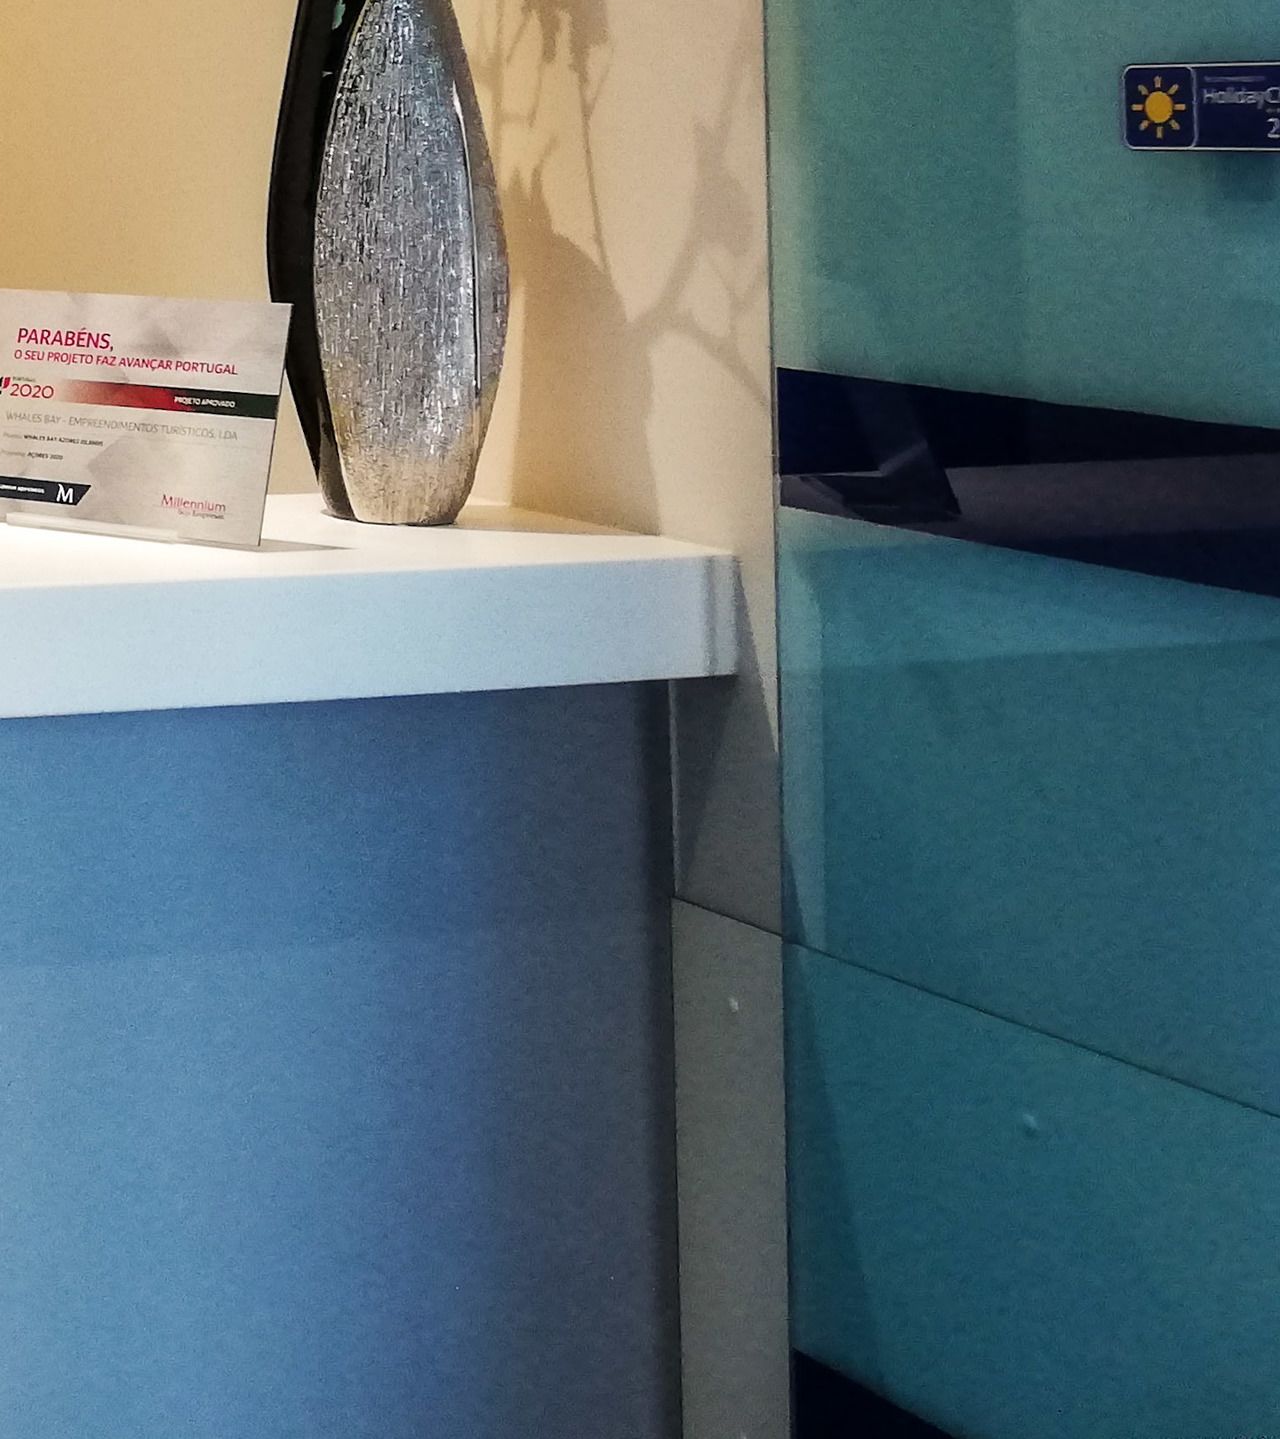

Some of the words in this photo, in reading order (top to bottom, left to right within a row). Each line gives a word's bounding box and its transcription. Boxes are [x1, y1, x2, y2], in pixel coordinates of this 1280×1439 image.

[17, 327, 115, 352] PARABÉNS,
[14, 350, 23, 360] O
[24, 350, 45, 361] SEU
[46, 351, 94, 366] PROJETO
[95, 355, 117, 366] FAZ
[119, 357, 173, 372] AVANÇAR
[175, 362, 239, 376] PORTUGAL
[9, 383, 55, 400] 2020
[173, 395, 200, 406] PROJETO
[5, 411, 42, 425] WHALES
[43, 413, 62, 426] BAY
[68, 415, 159, 435] EMPREENDIMENTOS
[161, 493, 227, 513] Millennium
